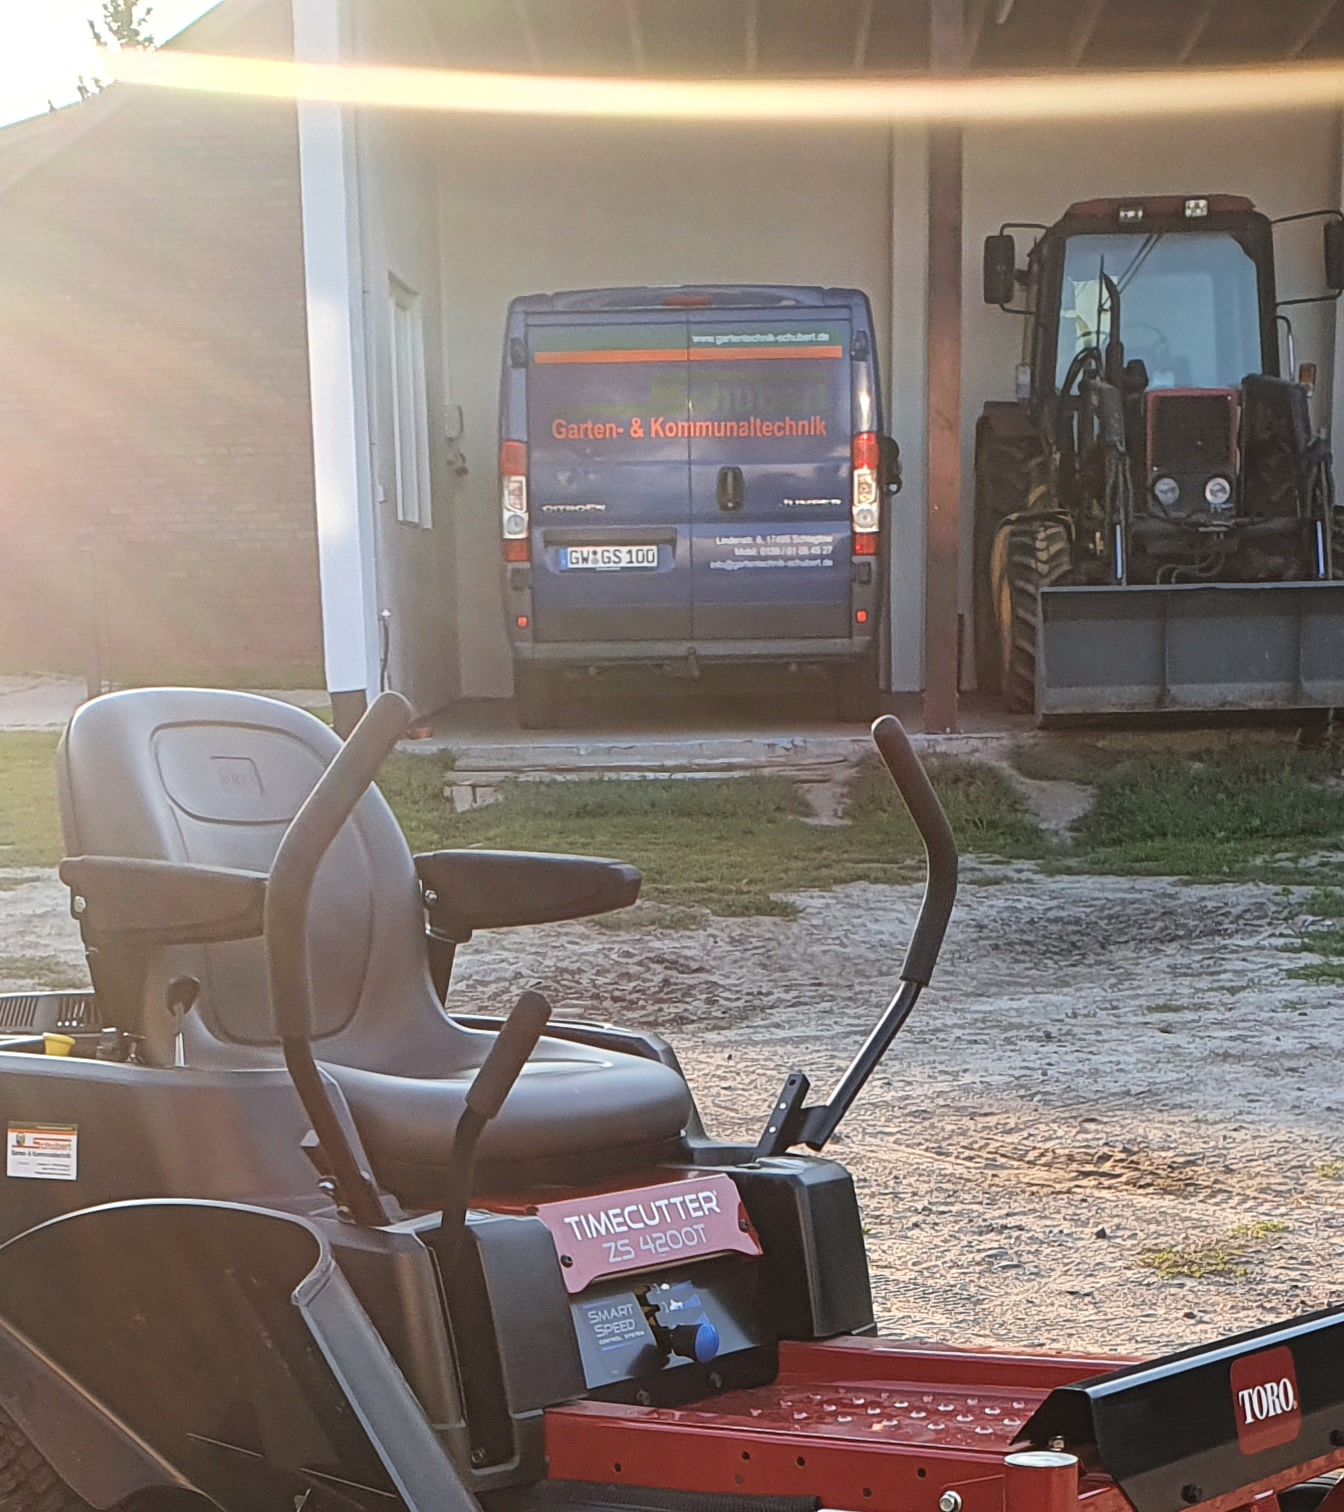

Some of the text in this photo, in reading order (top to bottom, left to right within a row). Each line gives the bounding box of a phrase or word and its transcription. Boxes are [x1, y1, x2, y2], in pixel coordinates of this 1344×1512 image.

[551, 416, 827, 440] Garten- & Kommunaltechnik
[569, 549, 655, 566] GW GS 100
[602, 1224, 707, 1263] ZS 4200T
[588, 1304, 633, 1324] SMART
[594, 1319, 636, 1338] SPEED
[1238, 1378, 1294, 1424] TORO
